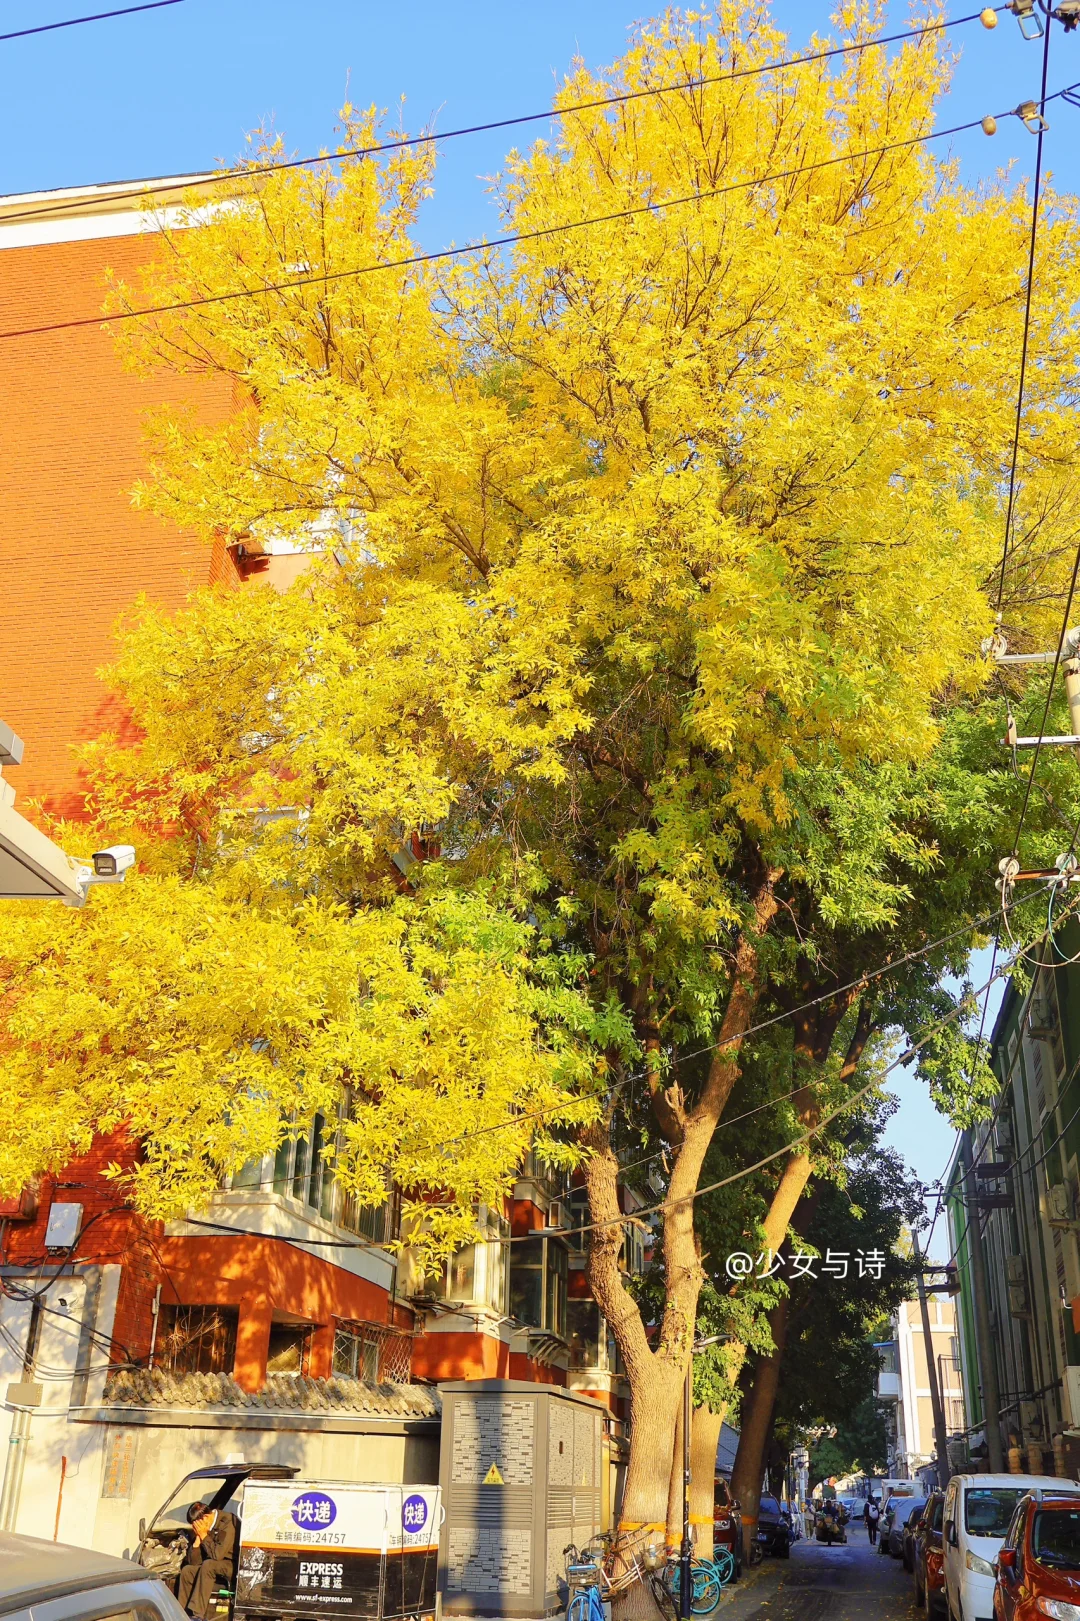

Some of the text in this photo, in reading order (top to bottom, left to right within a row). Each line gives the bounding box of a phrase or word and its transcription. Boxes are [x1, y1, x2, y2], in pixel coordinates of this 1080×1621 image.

[298, 1499, 331, 1523] 快递
[404, 1502, 425, 1526] 快递
[299, 1562, 343, 1576] EXPRESS
[298, 1574, 343, 1589] 顺丰速运
[295, 1593, 353, 1604] www.sf-express.com
